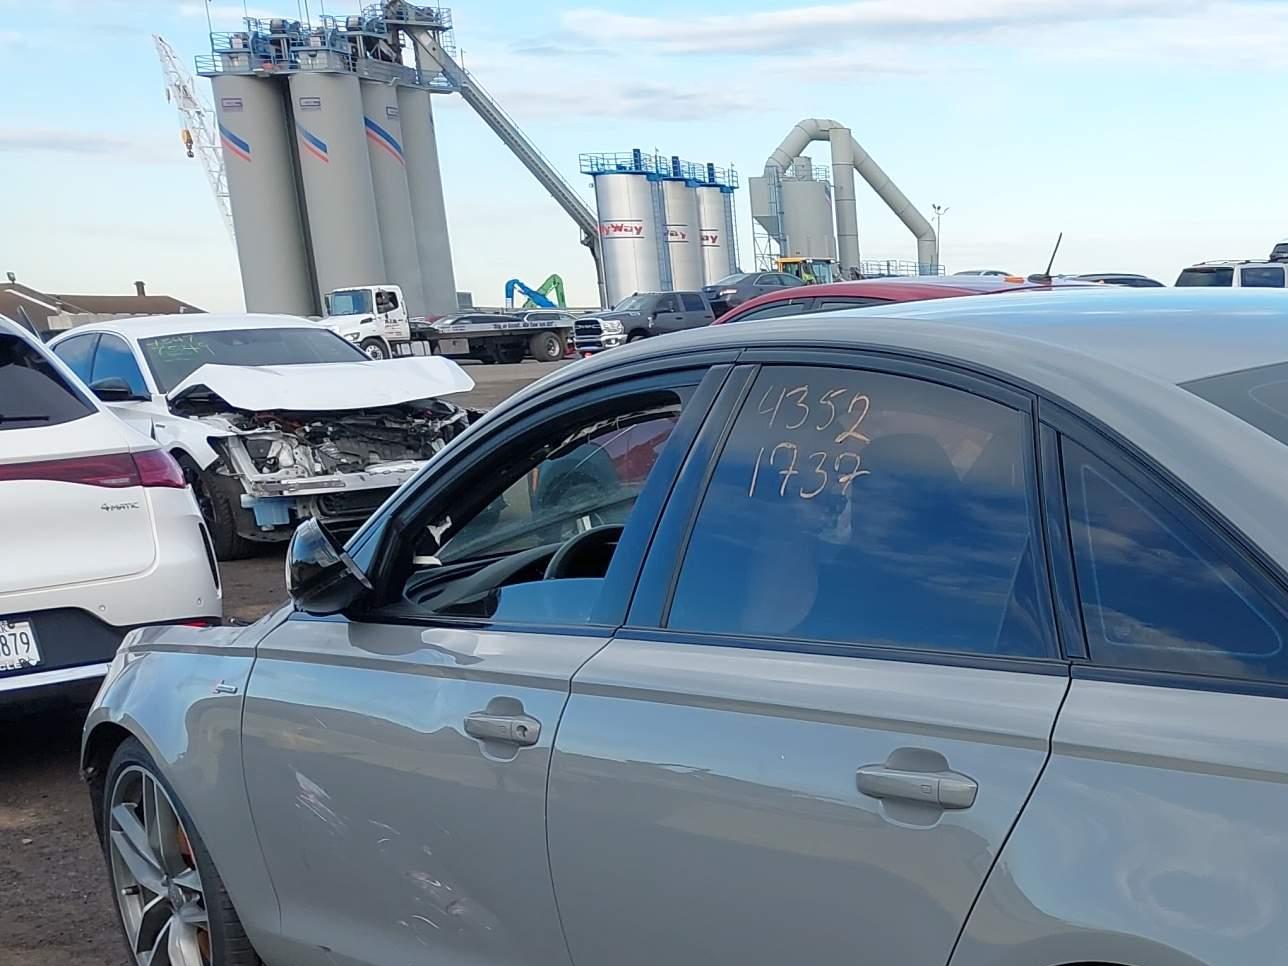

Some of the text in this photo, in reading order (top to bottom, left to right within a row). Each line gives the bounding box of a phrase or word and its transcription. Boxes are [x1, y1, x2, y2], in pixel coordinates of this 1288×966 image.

[758, 384, 871, 443] 4352
[748, 442, 871, 499] 1737
[100, 502, 140, 512] 4MATIC
